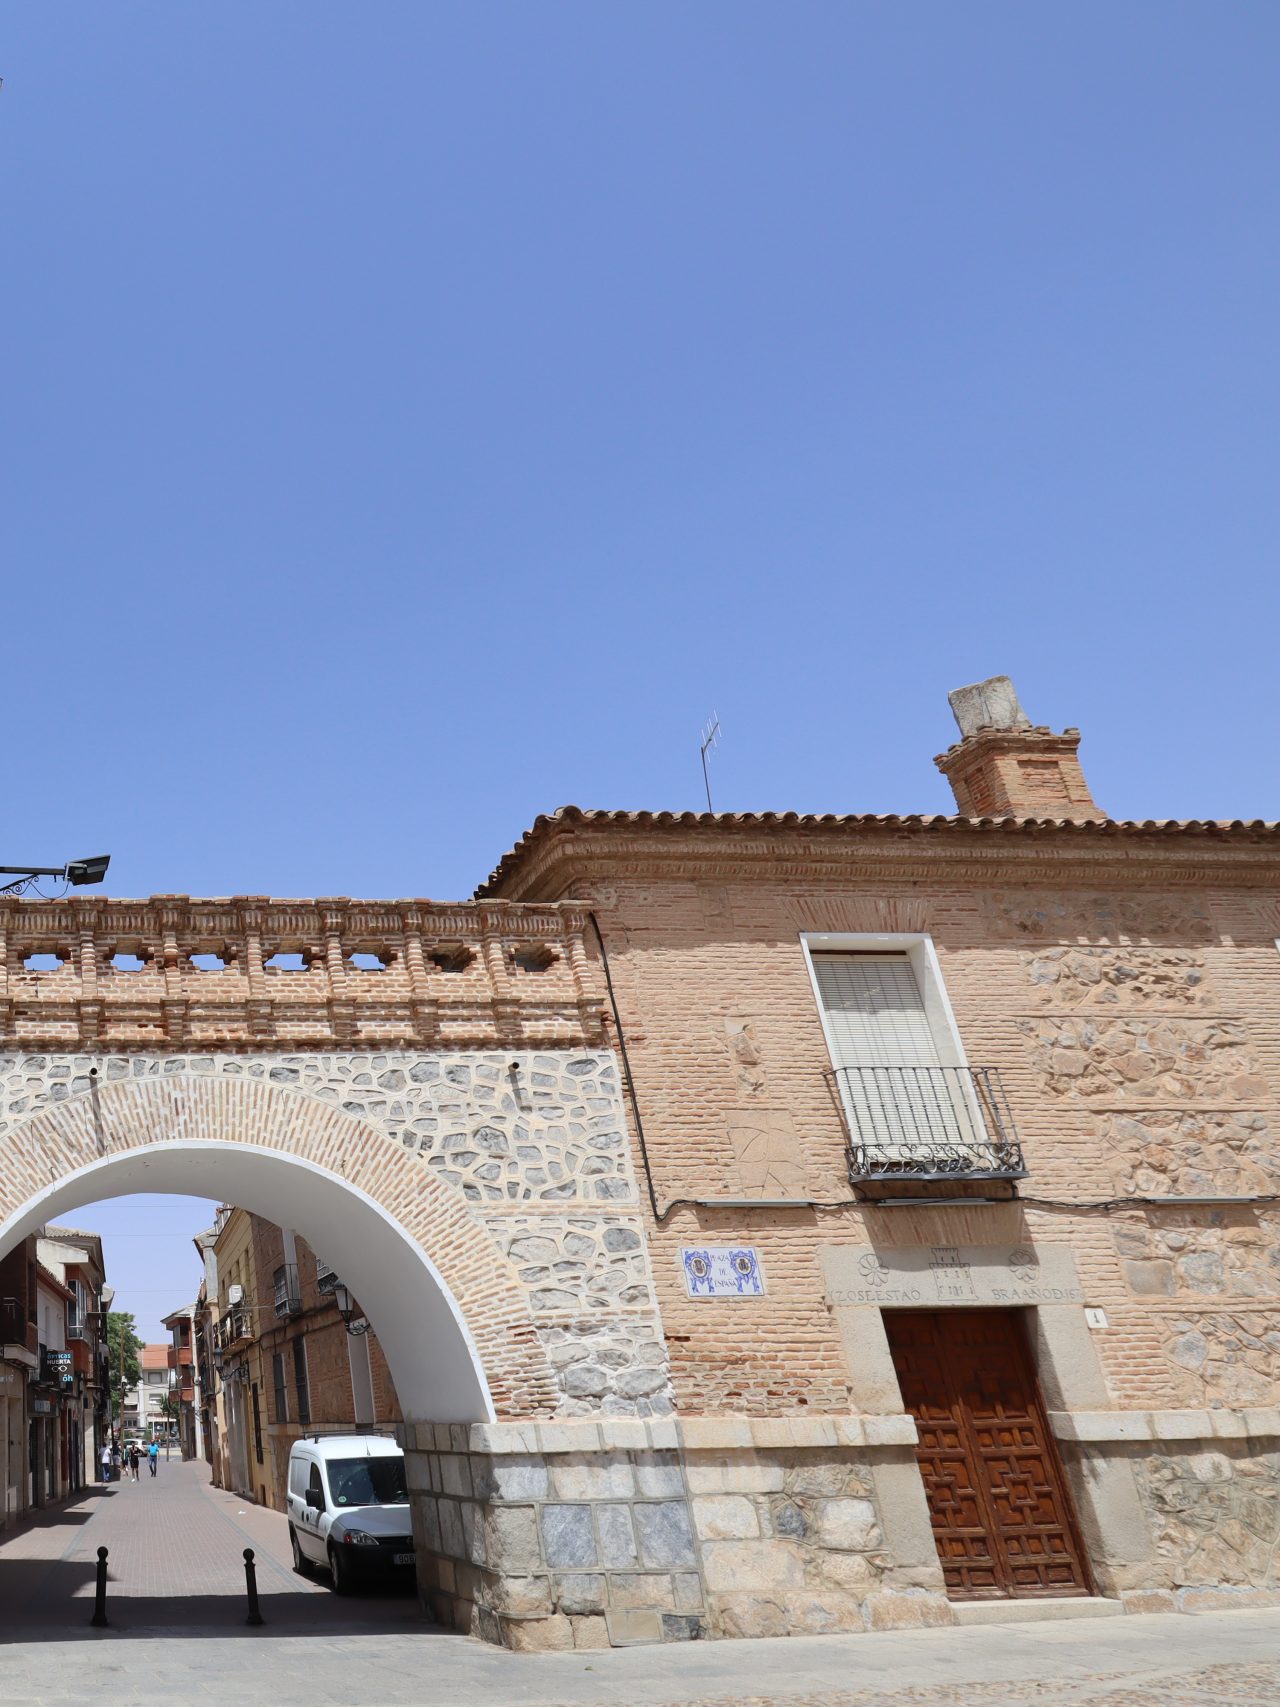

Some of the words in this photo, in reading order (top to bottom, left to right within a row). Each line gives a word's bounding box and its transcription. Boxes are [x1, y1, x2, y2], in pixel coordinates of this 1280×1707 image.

[718, 1268, 727, 1276] DE
[714, 1279, 737, 1288] ESPAÑA
[1093, 1311, 1100, 1323] 1
[399, 1554, 416, 1563] 906
